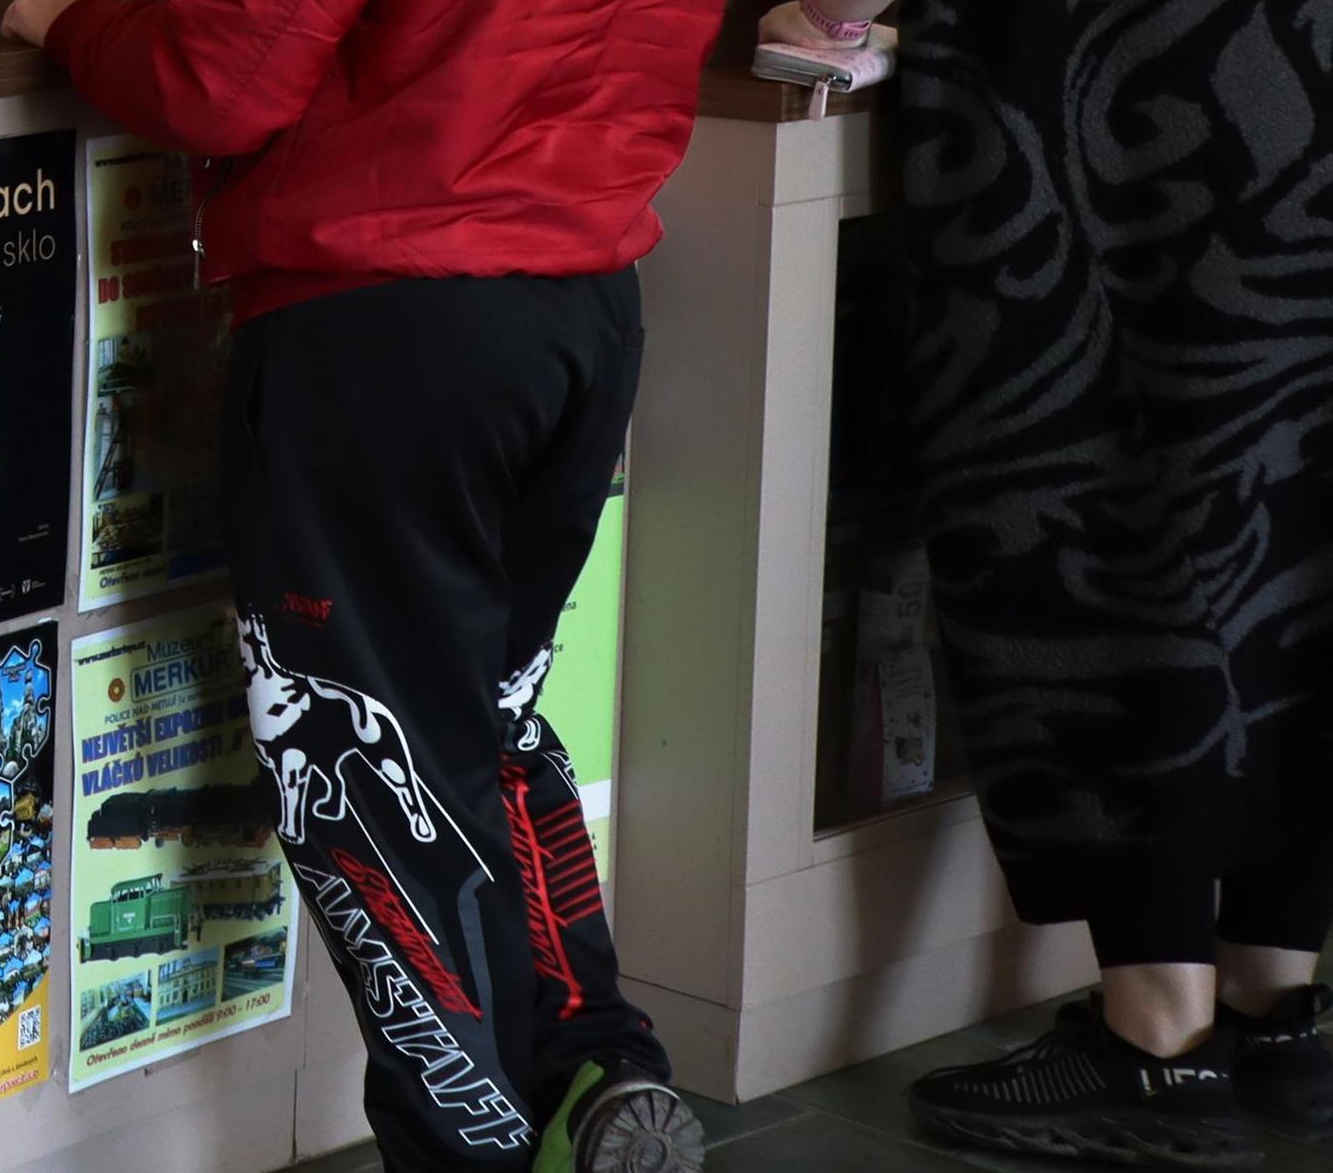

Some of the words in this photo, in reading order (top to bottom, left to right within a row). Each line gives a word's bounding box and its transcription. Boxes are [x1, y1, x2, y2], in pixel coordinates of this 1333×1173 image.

[1, 227, 57, 268] sklo
[81, 717, 153, 764] NEJVĚTŠÍ
[81, 751, 145, 797] VLÁČKŮ
[85, 1043, 129, 1068] Otevřeno
[244, 991, 271, 1013] 17:00
